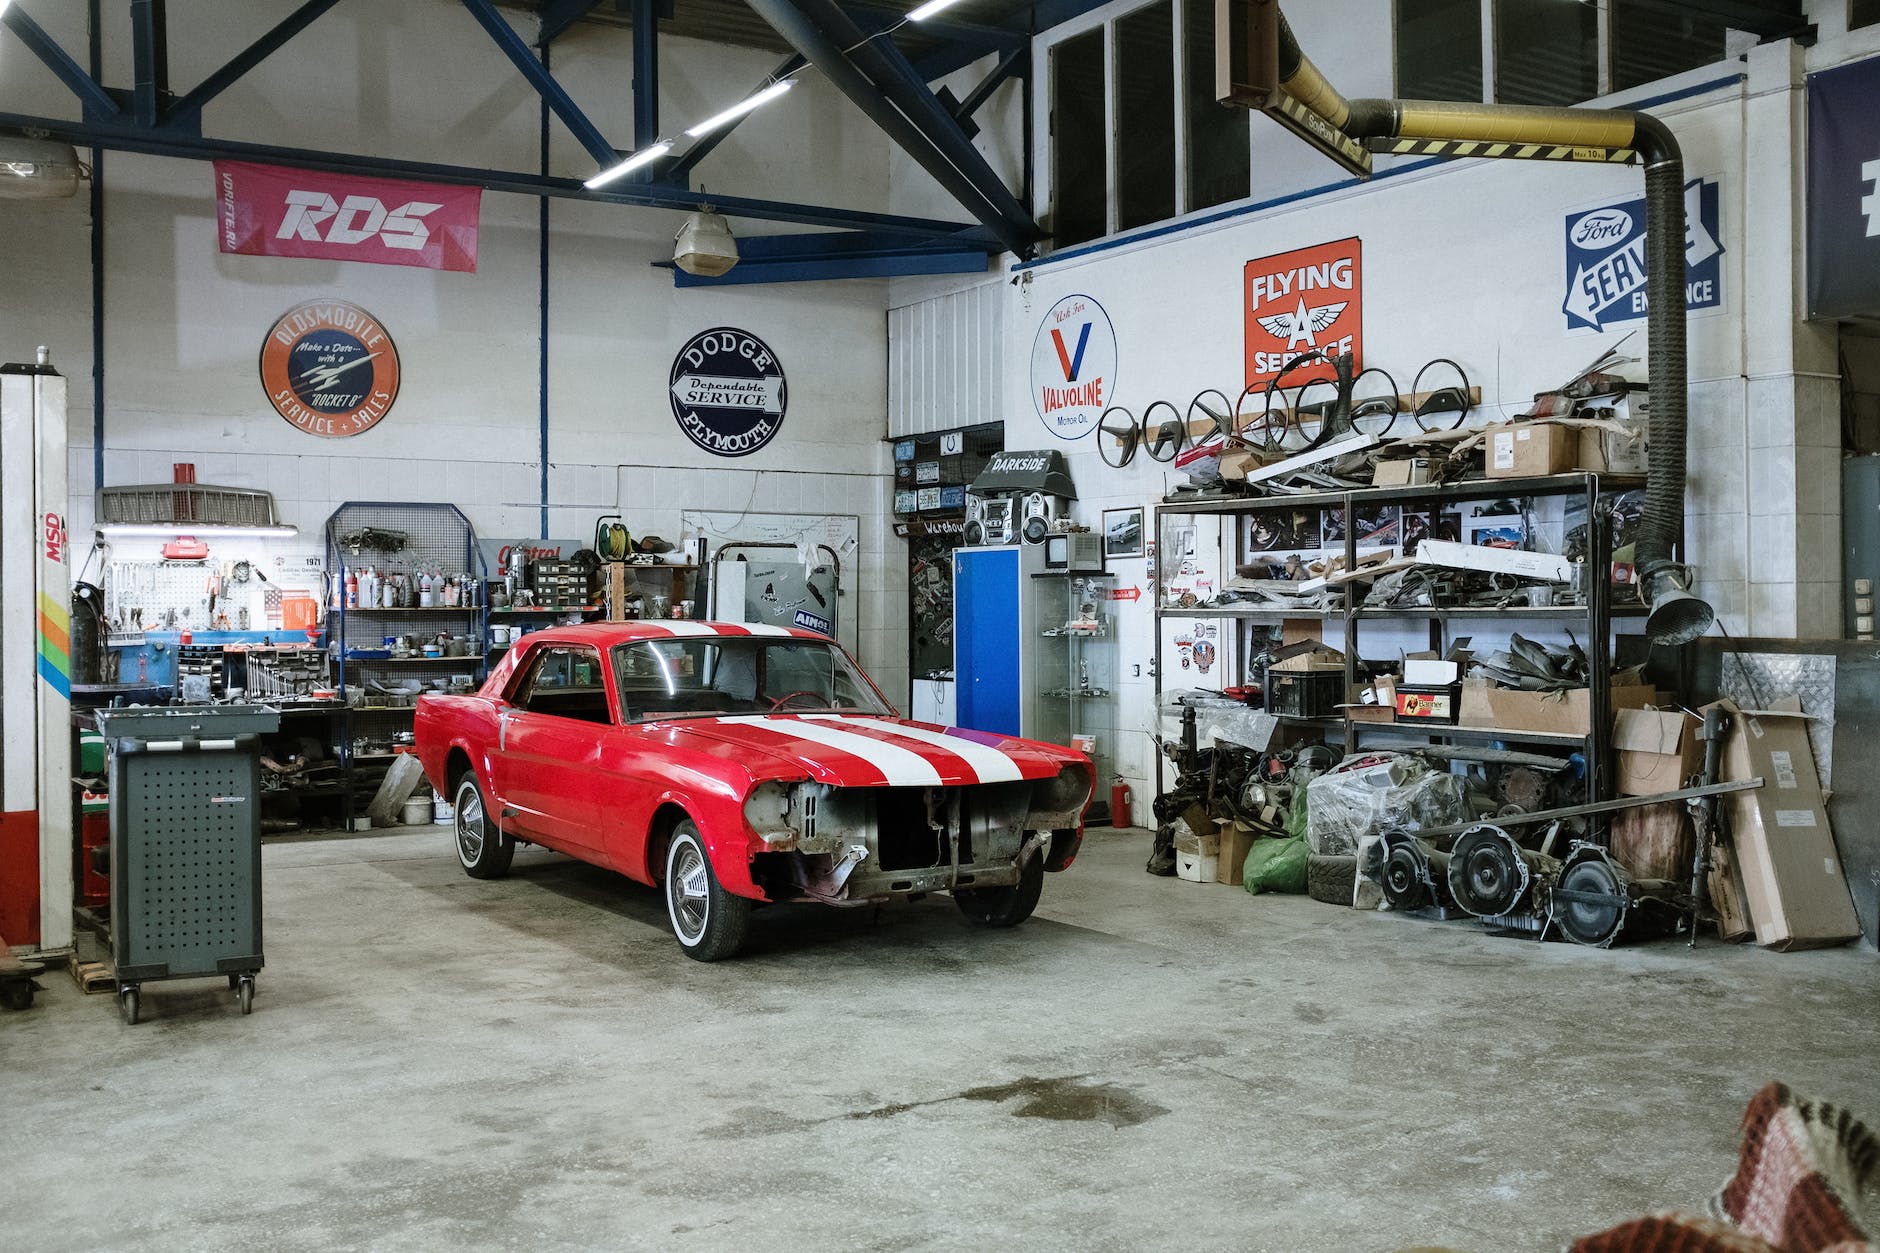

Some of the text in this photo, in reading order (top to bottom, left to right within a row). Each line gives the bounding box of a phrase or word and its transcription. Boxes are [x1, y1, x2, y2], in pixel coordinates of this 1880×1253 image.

[275, 189, 444, 250] RDS
[1576, 215, 1627, 243] Ford
[1582, 208, 1695, 311] SERV
[1252, 258, 1353, 312] FLYING
[1632, 280, 1713, 313] ENNCE
[275, 307, 384, 349] OLDSMOBILE
[295, 342, 323, 352] Make
[317, 353, 336, 362] with
[684, 333, 772, 373] DODGE
[685, 391, 767, 406] SERVICE
[690, 378, 765, 392] Dependable
[1042, 377, 1102, 413] VALVOLINE
[275, 390, 335, 434] SERVICE
[351, 390, 390, 429] SALES
[683, 411, 772, 451] PLYMOUTH
[991, 457, 1047, 471] DARKSIDE
[45, 513, 61, 563] MSD
[498, 545, 561, 564] Cstrol
[1418, 699, 1442, 708] Banner
